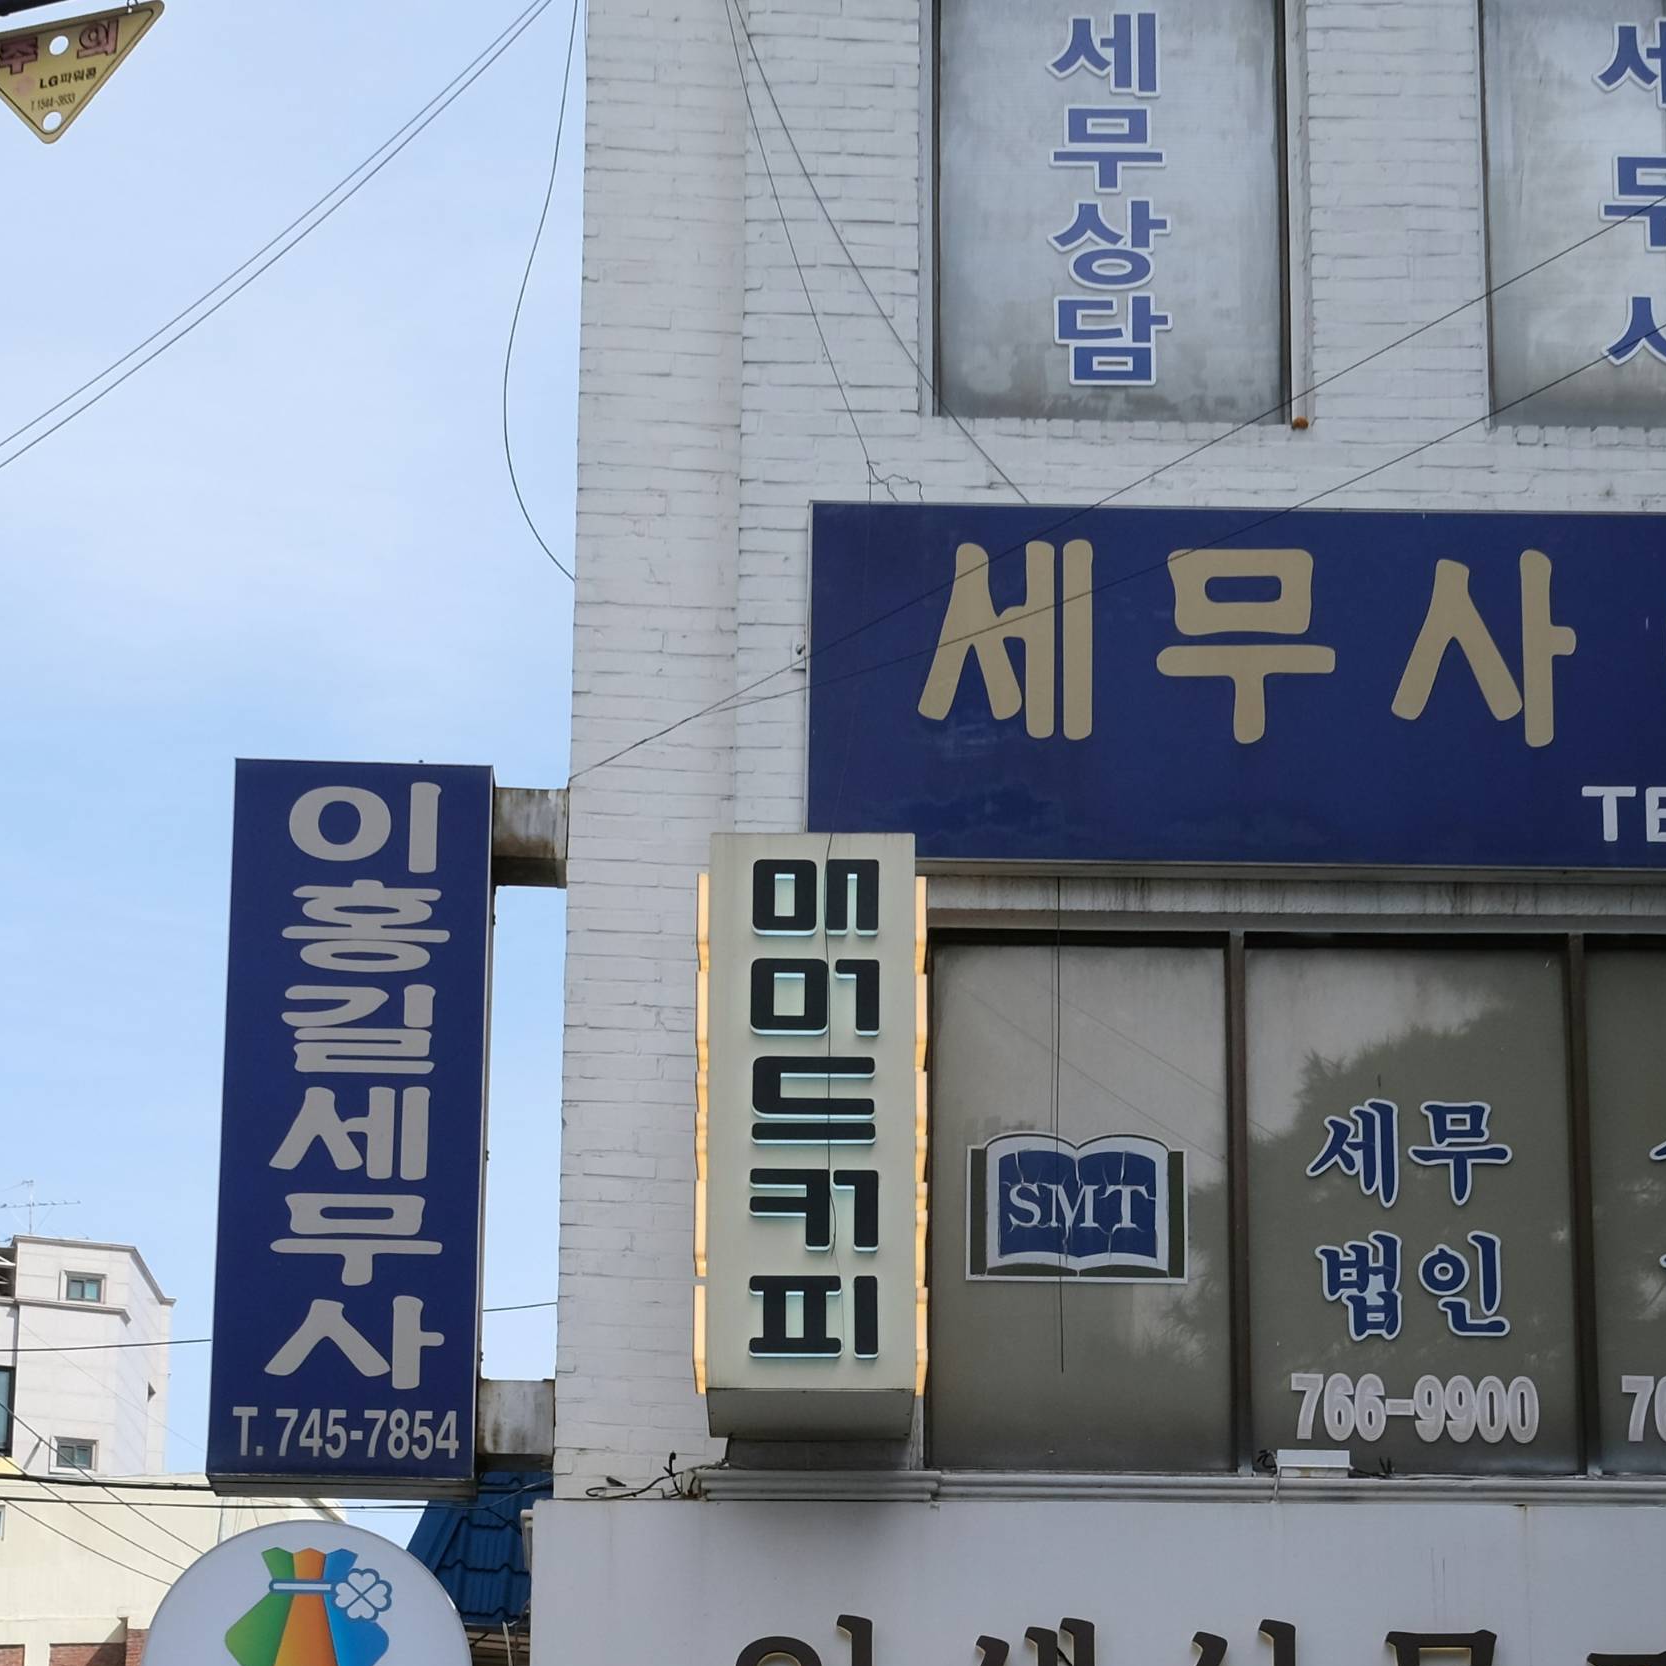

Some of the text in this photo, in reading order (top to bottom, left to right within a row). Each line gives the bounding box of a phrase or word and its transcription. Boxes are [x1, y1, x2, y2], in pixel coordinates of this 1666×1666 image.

[1046, 12, 1173, 388] 세무상담
[918, 538, 1576, 749] 세무사
[1008, 1182, 1150, 1231] SMT
[275, 1407, 460, 1461] 745-7854
[1290, 1372, 1539, 1445] 766-9900
